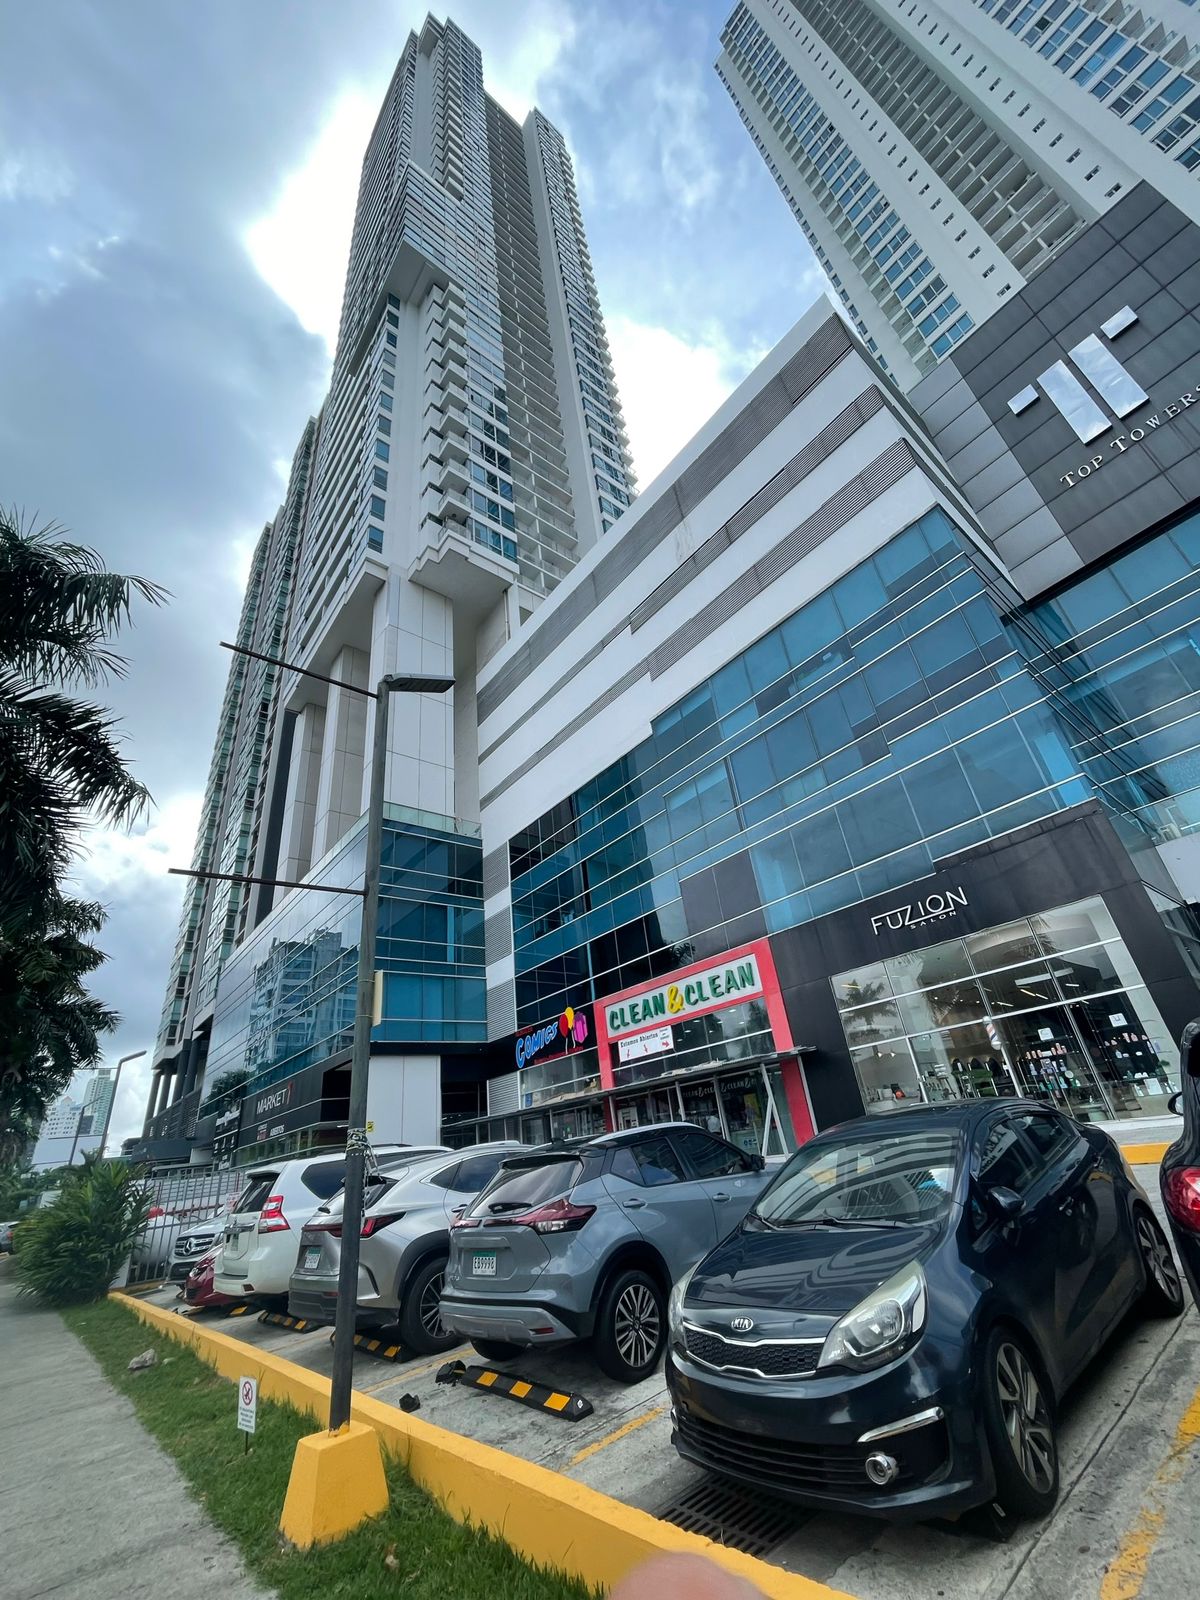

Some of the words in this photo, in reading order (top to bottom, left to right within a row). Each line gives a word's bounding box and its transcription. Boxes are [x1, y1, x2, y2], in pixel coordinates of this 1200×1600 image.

[1060, 455, 1103, 488] TOP
[871, 887, 968, 935] FUZION
[910, 911, 956, 929] SALON
[257, 1088, 287, 1114] MARKET
[734, 1318, 749, 1329] KIA
